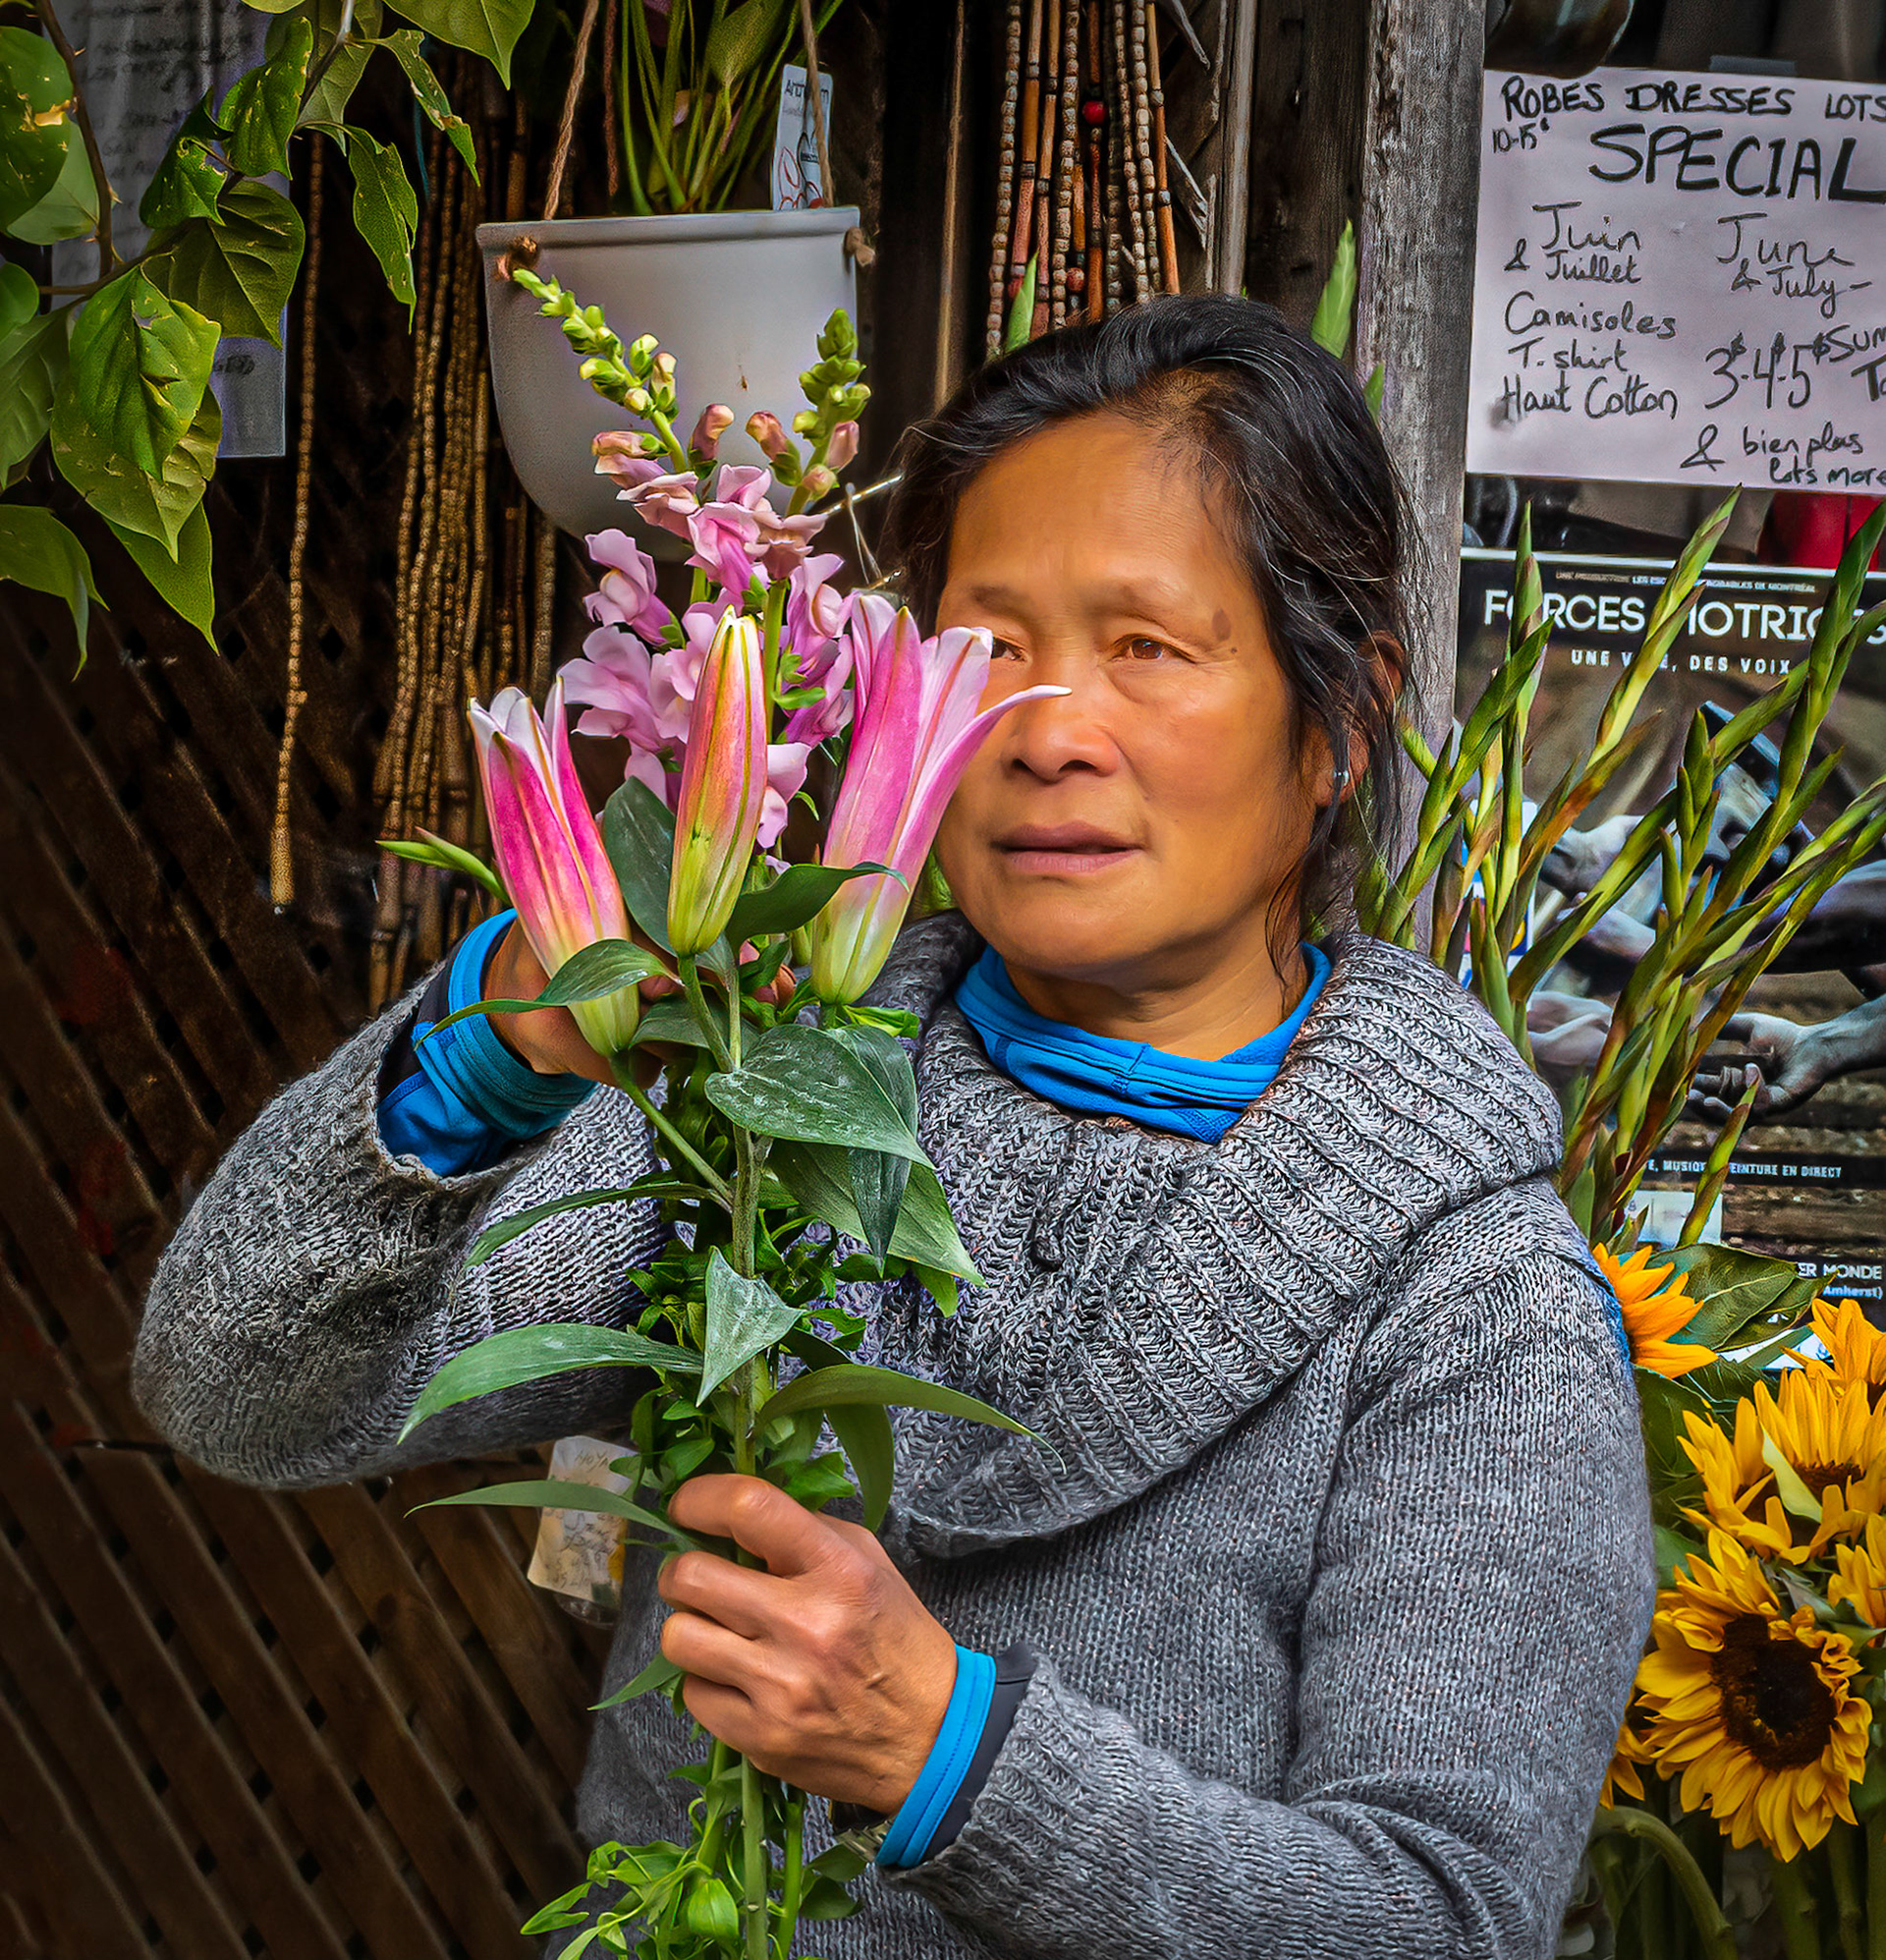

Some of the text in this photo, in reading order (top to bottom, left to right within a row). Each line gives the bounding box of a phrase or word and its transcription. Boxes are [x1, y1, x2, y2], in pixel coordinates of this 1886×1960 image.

[1501, 75, 1886, 123] ROBES DRESSES LOTS
[1588, 124, 1886, 202] SPECIAL
[1531, 201, 1641, 252] Juin
[1715, 212, 1856, 266] June
[1545, 249, 1641, 284] Juillet
[1504, 291, 1677, 339] Camisoles
[1503, 369, 1679, 422] Haut Cotton
[1744, 423, 1799, 455] bien
[1828, 466, 1886, 487] more
[1484, 589, 1886, 644] FRCES OTRI
[1571, 649, 1791, 675] UNE VE, DES VOIX
[1729, 1162, 1778, 1176] EINTURE
[1782, 1165, 1798, 1176] EN
[1801, 1165, 1842, 1178] DIRECT
[1823, 1263, 1882, 1280] MONDE
